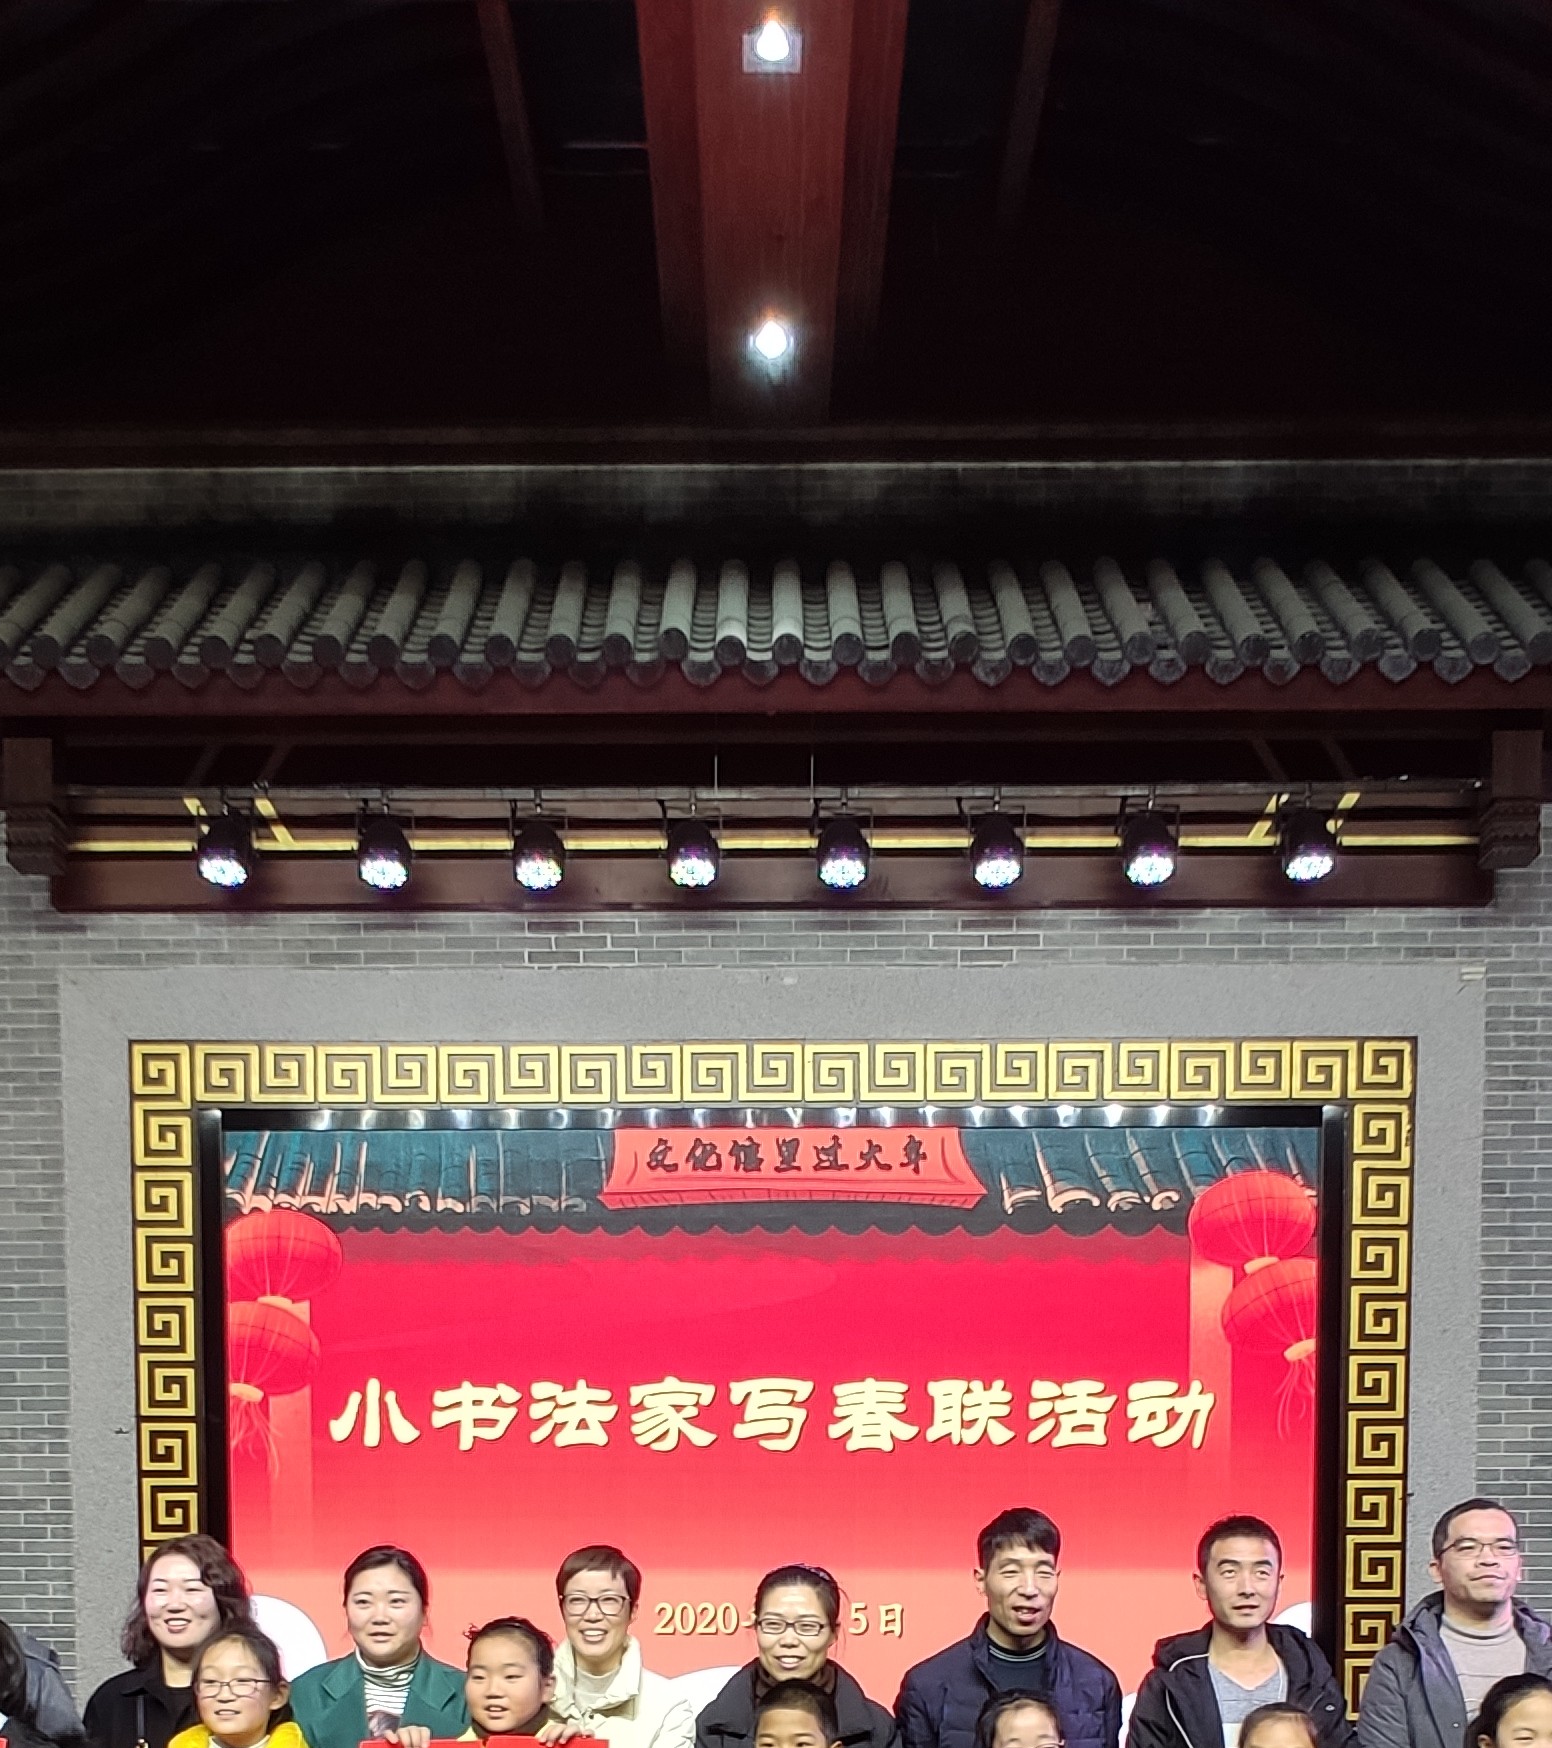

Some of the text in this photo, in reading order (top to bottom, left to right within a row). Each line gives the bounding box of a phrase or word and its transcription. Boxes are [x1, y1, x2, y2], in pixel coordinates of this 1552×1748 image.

[328, 1376, 1218, 1453] 小书法家写春联活动
[653, 1602, 756, 1635] 2020
